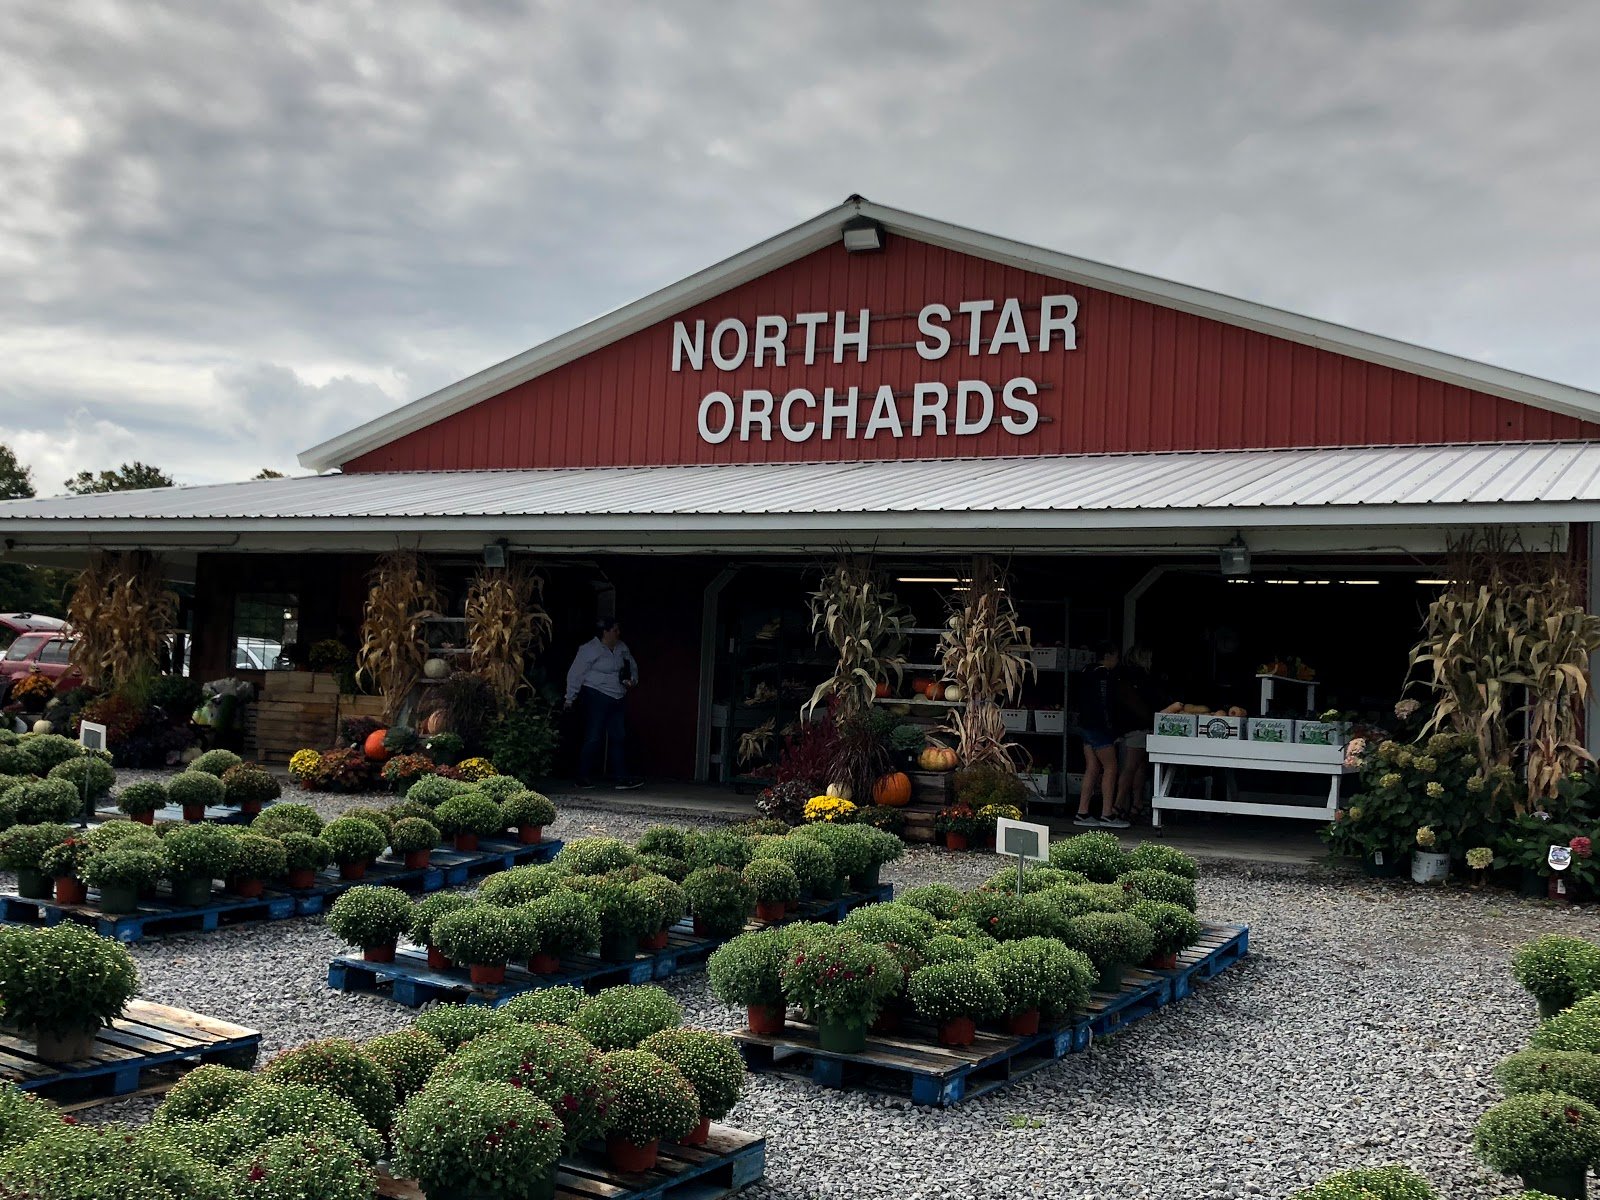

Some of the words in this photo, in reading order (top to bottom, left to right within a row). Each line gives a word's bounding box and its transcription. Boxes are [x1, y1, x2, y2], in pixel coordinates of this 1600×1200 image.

[671, 309, 870, 372] NORTH
[915, 294, 1078, 360] STAR
[697, 376, 1040, 444] ORCHARDS
